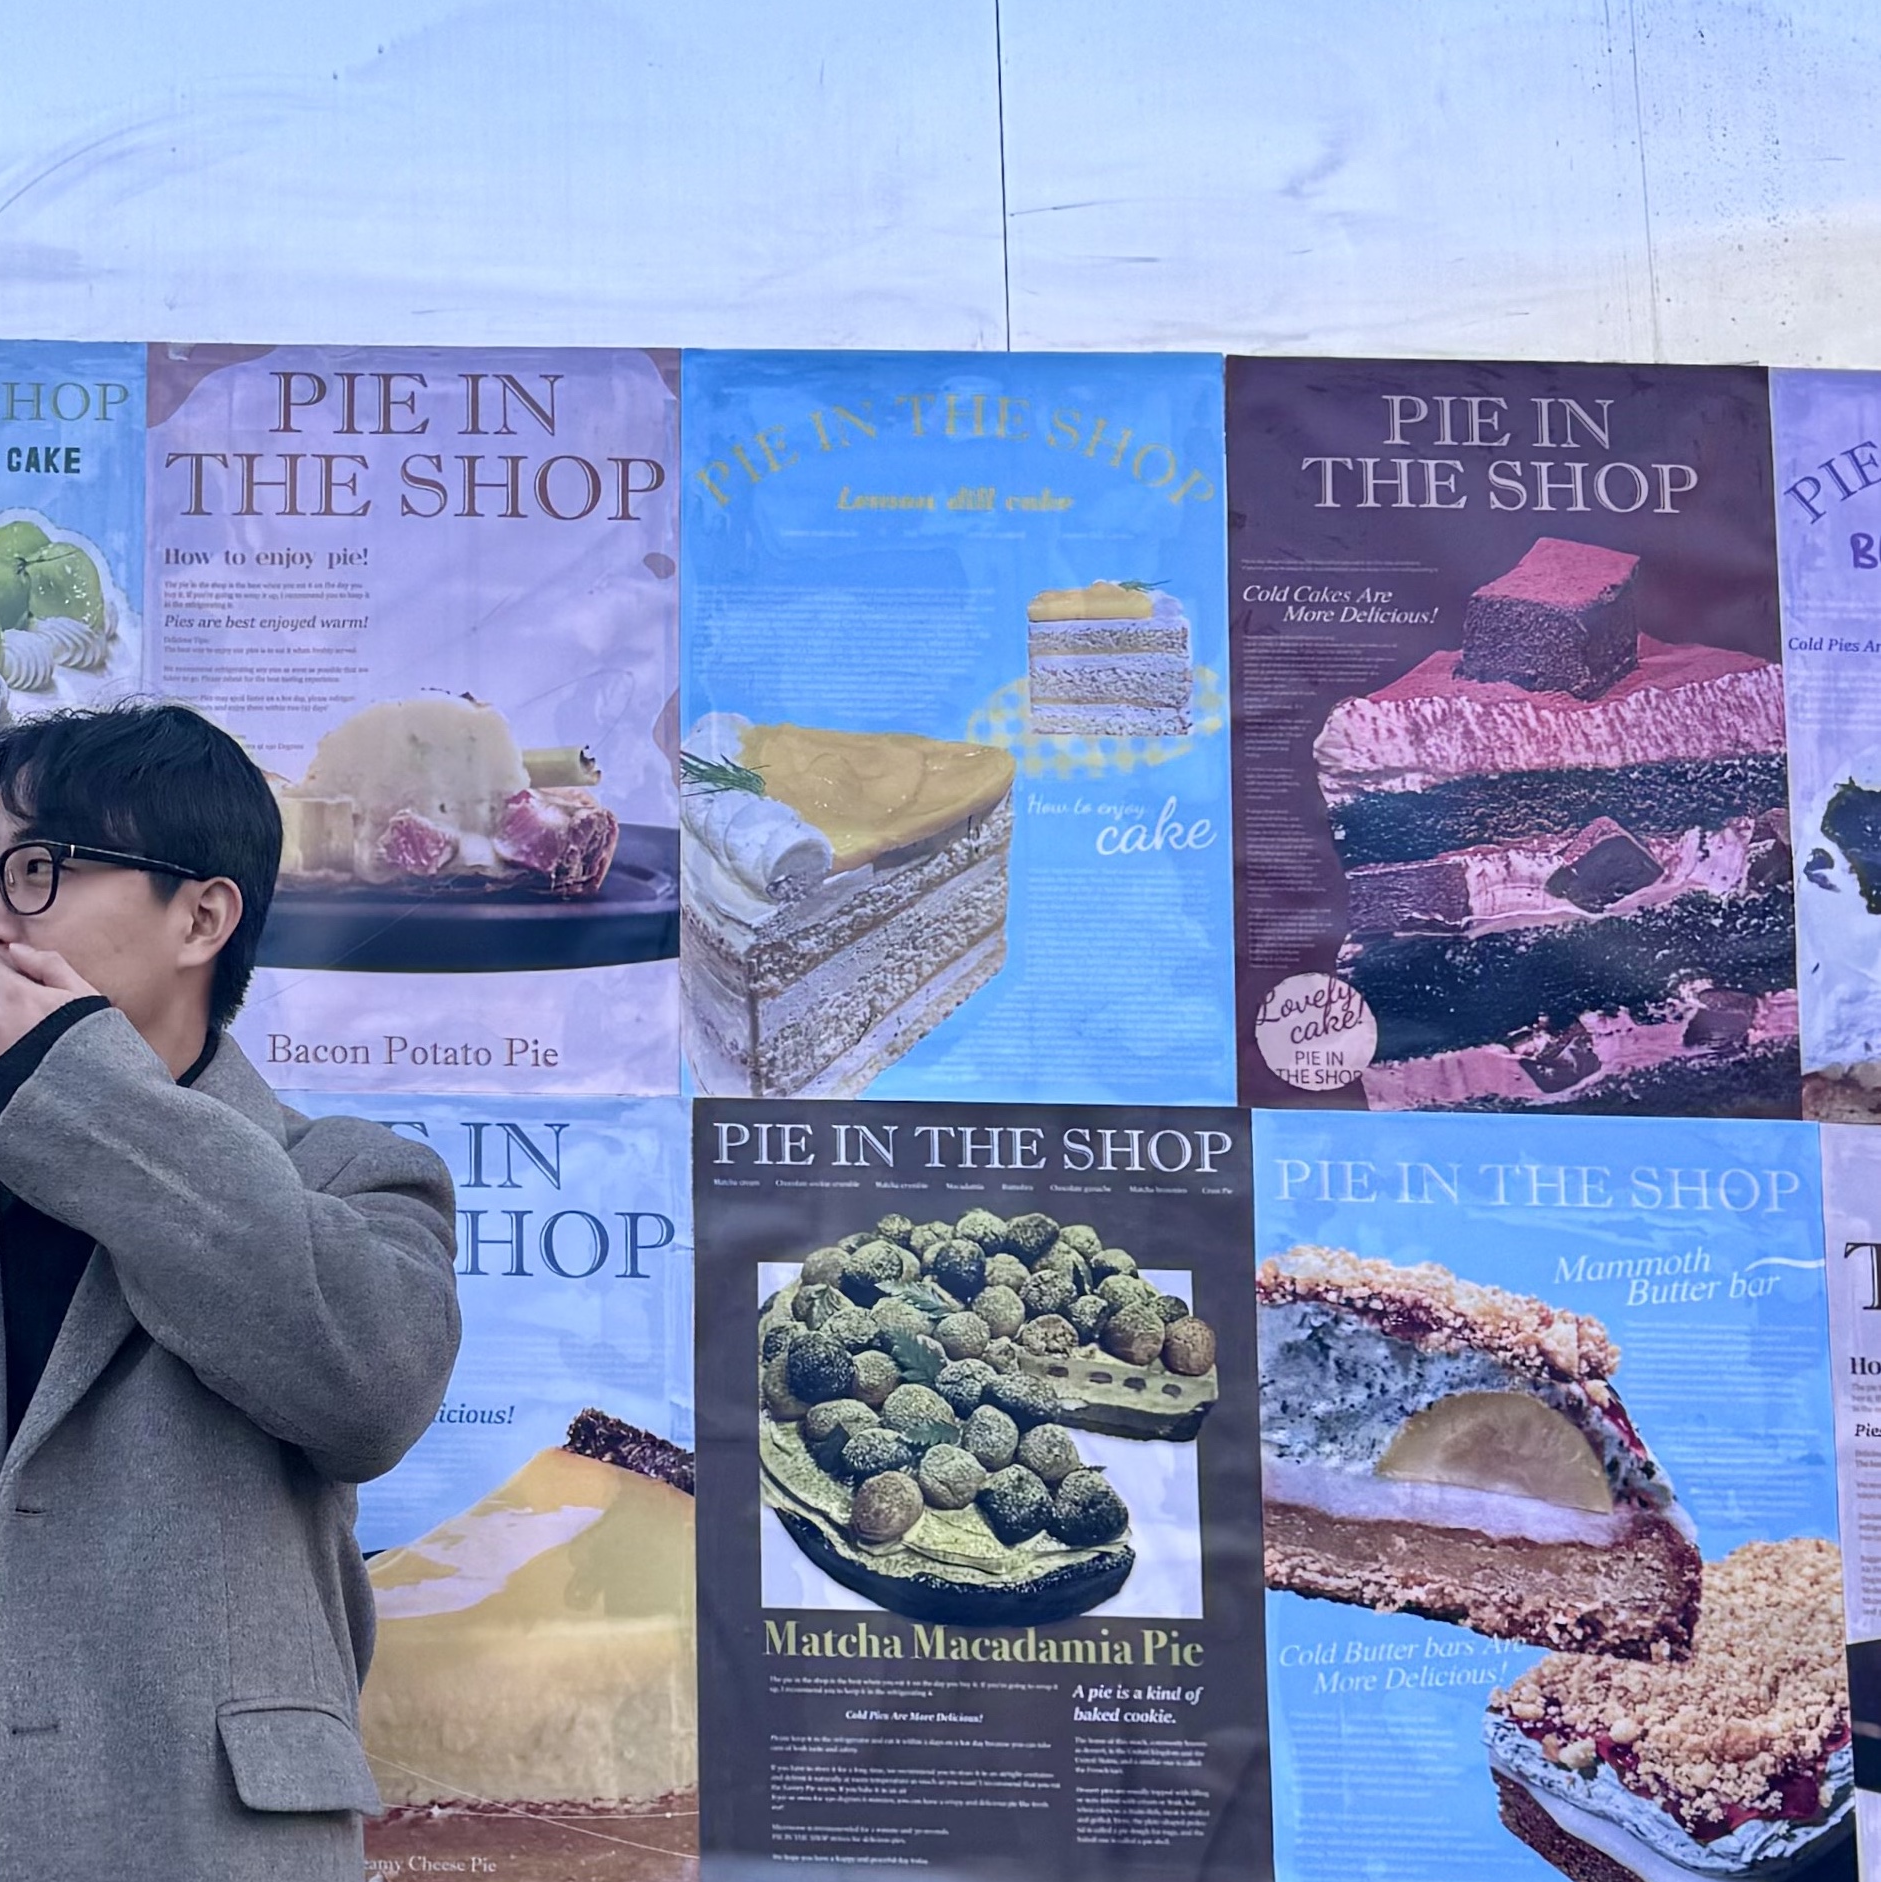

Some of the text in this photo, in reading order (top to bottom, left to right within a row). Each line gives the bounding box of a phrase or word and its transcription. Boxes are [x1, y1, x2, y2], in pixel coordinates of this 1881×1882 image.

[269, 371, 565, 437] PIE IN
[1381, 394, 1614, 451] PIE IN
[6, 446, 82, 474] CAKE
[695, 393, 1216, 507] PIE IN THE SHOP
[164, 453, 666, 522] THE SHOP
[837, 486, 935, 511] Lemon
[1005, 487, 1074, 512] cake
[1301, 456, 1699, 514] THE SHOP
[1783, 440, 1881, 525] PIE
[164, 547, 370, 570] How to enjoy pie!
[1242, 585, 1392, 605] Cold Cakes Are
[164, 615, 370, 632] Pies are best enjoyed warm!
[1283, 604, 1438, 626] More Delicious!
[1788, 637, 1861, 653] Cold Pies
[1027, 794, 1146, 823] How to enjoy
[1095, 795, 1217, 856] cake
[1256, 975, 1355, 1026] Lovely
[1290, 1000, 1364, 1044] cake!
[267, 1033, 559, 1068] Bacon Potato Pie
[1295, 1051, 1344, 1066] PIE IN
[1276, 1068, 1310, 1084] THE
[459, 1122, 570, 1190] IN
[713, 1122, 1233, 1173] PIE IN THE SHOP
[1275, 1159, 1378, 1203] PIE
[1396, 1161, 1463, 1205] IN
[1480, 1163, 1614, 1209] THE
[1630, 1167, 1800, 1212] SHOP
[456, 1209, 675, 1279] HOP
[1553, 1246, 1711, 1285] Mammoth
[1626, 1271, 1781, 1307] Butter bar
[762, 1619, 1205, 1668] Matcha Macadamia Pie
[1072, 1685, 1084, 1698] A
[1087, 1685, 1112, 1702] pie
[1116, 1685, 1130, 1699] is
[1133, 1688, 1142, 1700] a
[1146, 1686, 1182, 1701] kind
[1185, 1687, 1204, 1705] of
[845, 1710, 868, 1720] Cold
[891, 1711, 908, 1721] Are
[909, 1711, 935, 1722] More
[936, 1712, 983, 1723] Delicious!
[1074, 1707, 1176, 1724] baked cookie.
[408, 1855, 497, 1872] Cheese Pie
